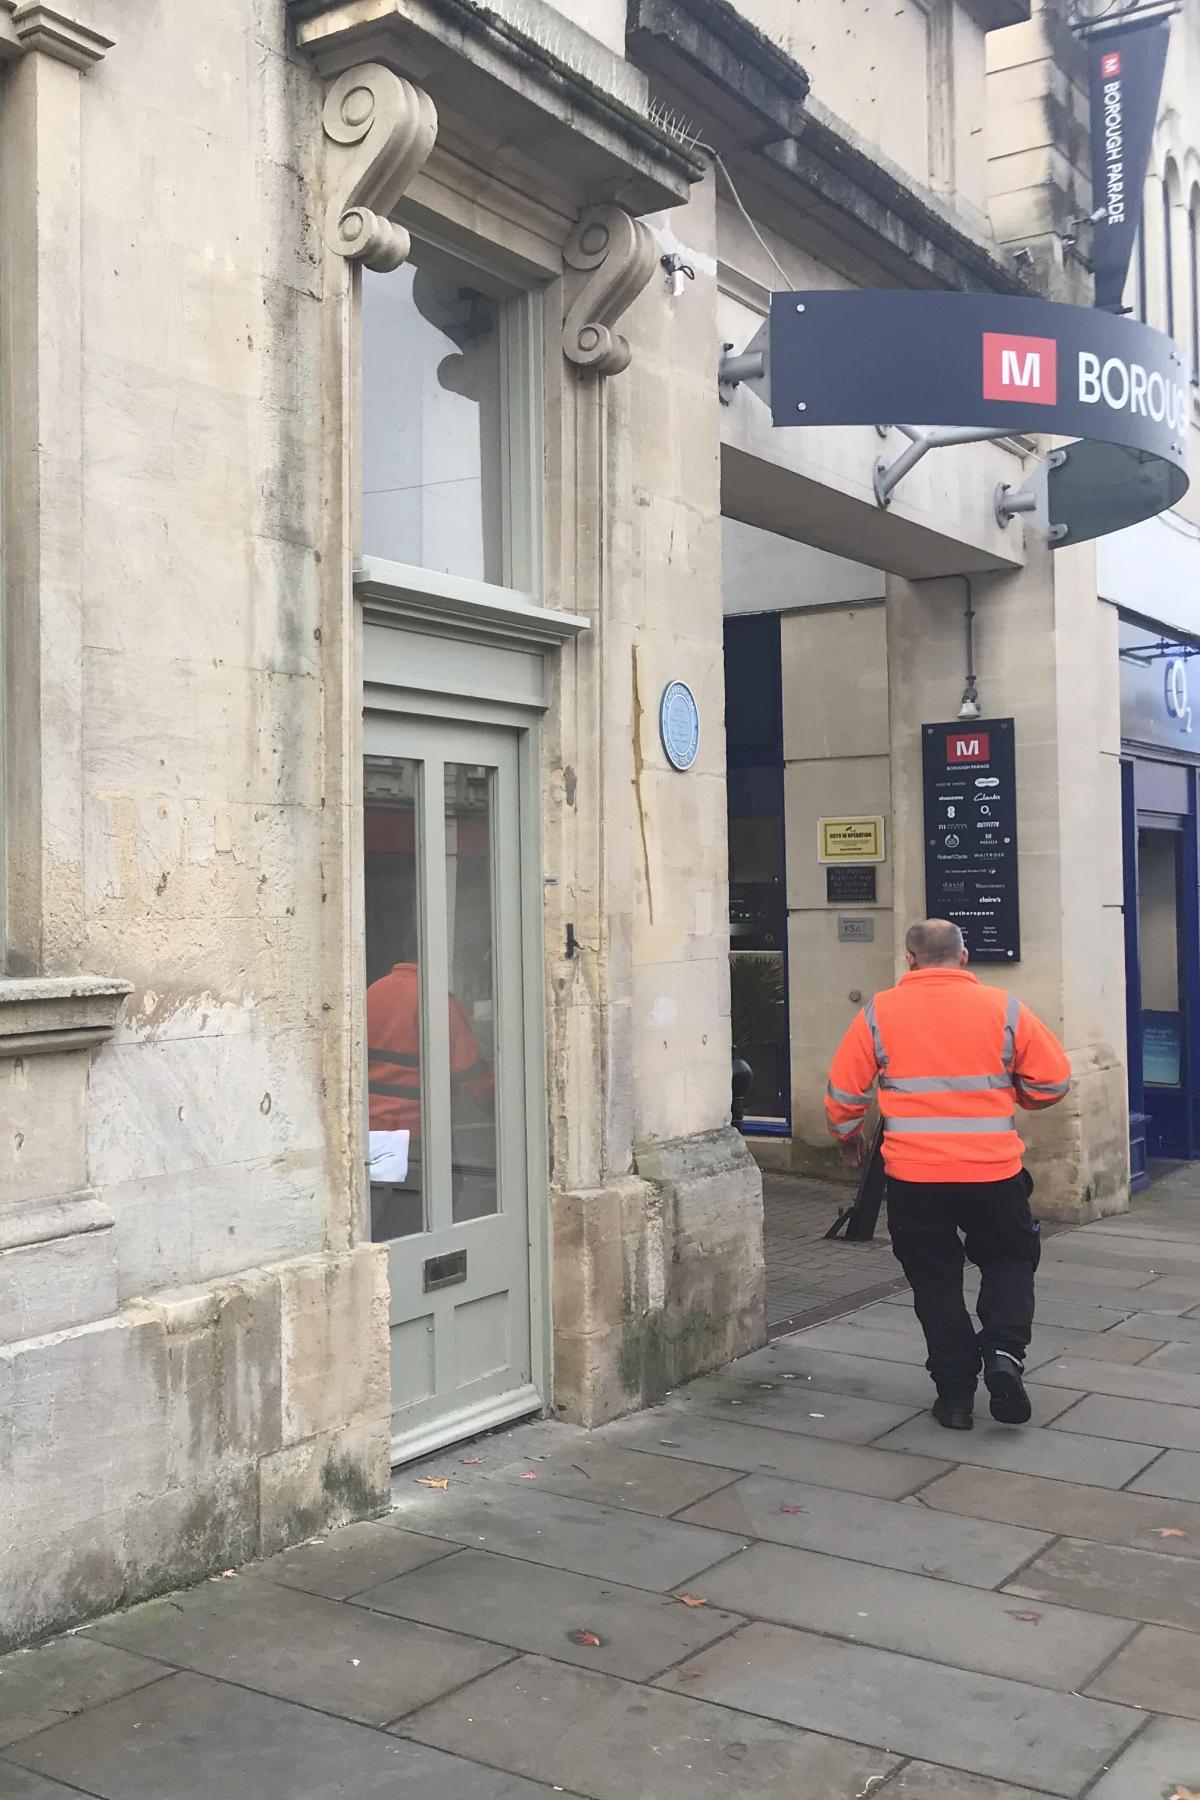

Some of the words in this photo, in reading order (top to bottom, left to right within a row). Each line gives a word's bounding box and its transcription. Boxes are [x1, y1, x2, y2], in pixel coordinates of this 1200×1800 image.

[1103, 80, 1122, 161] BOROUGH
[1106, 163, 1125, 225] PARADE
[1002, 351, 1040, 388] M
[956, 740, 980, 756] M
